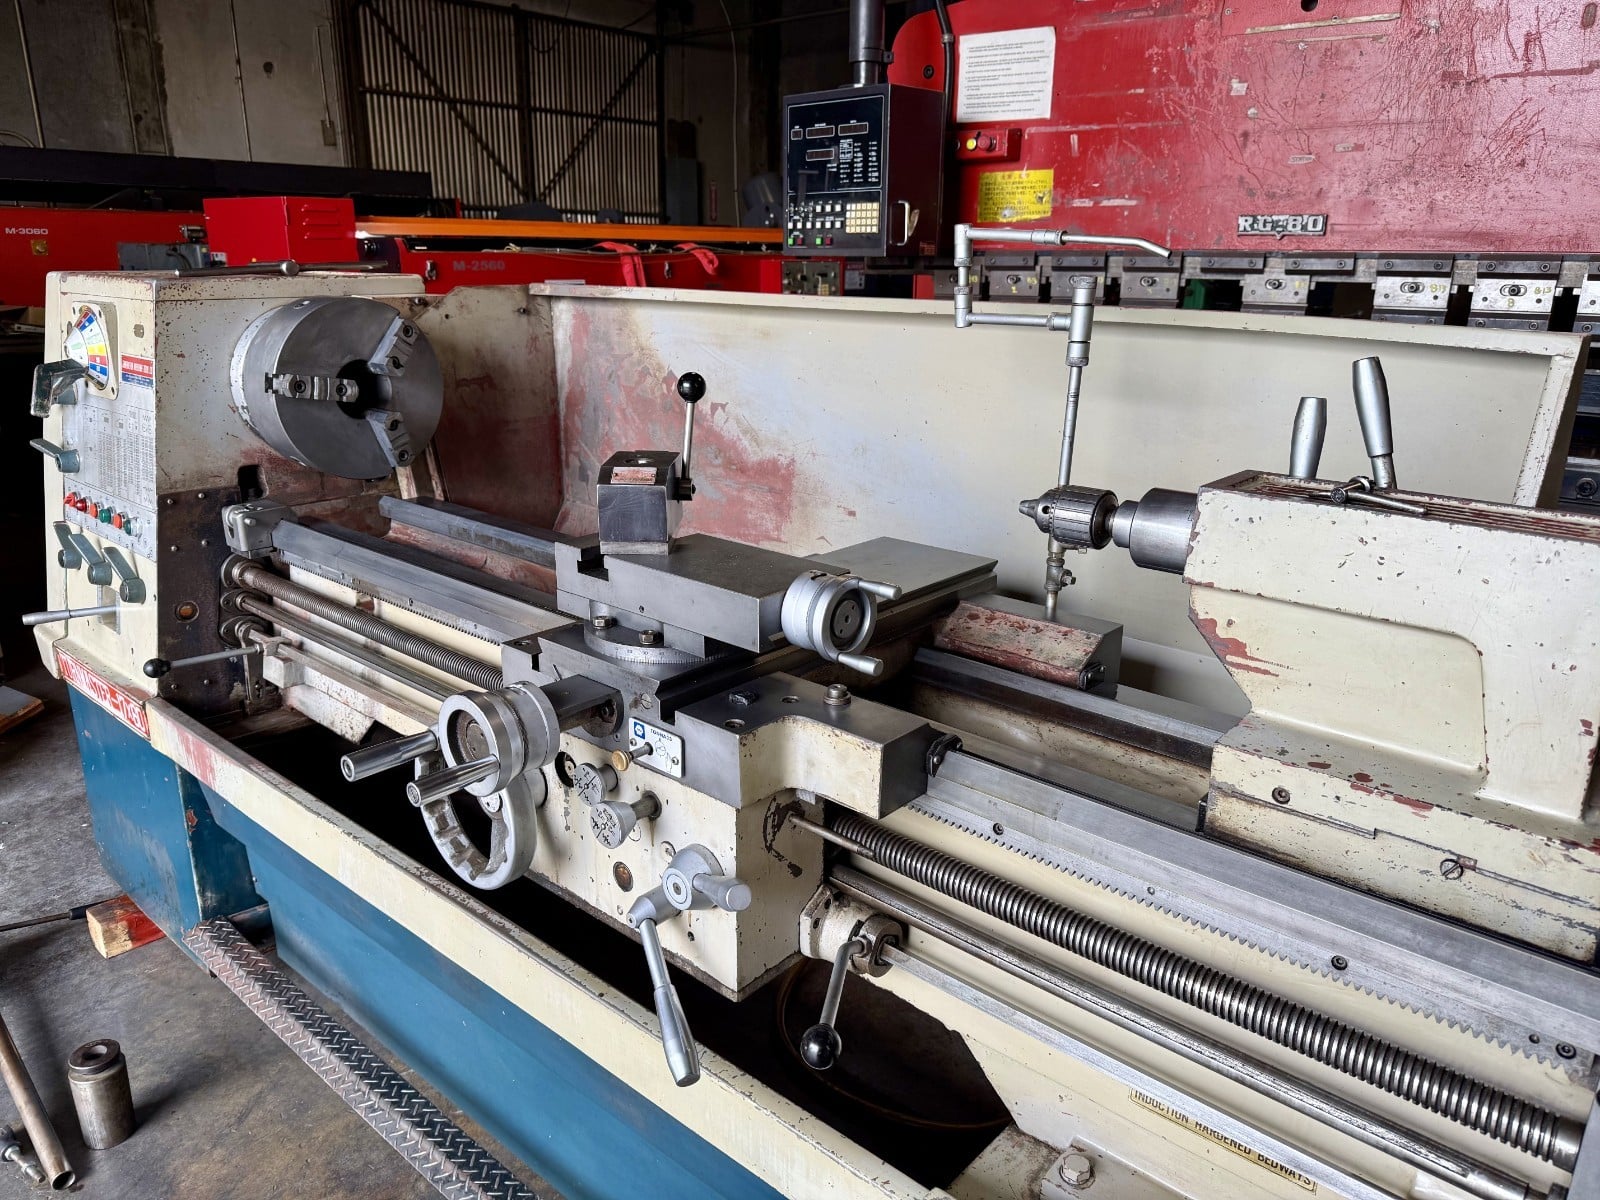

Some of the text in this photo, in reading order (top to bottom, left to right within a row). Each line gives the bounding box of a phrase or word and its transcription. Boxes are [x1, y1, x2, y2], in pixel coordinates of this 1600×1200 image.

[5, 227, 49, 235] M-3060
[452, 260, 505, 271] M-2560
[1195, 1121, 1251, 1155] HARDENED
[1257, 1153, 1311, 1186] BEDWAYS
